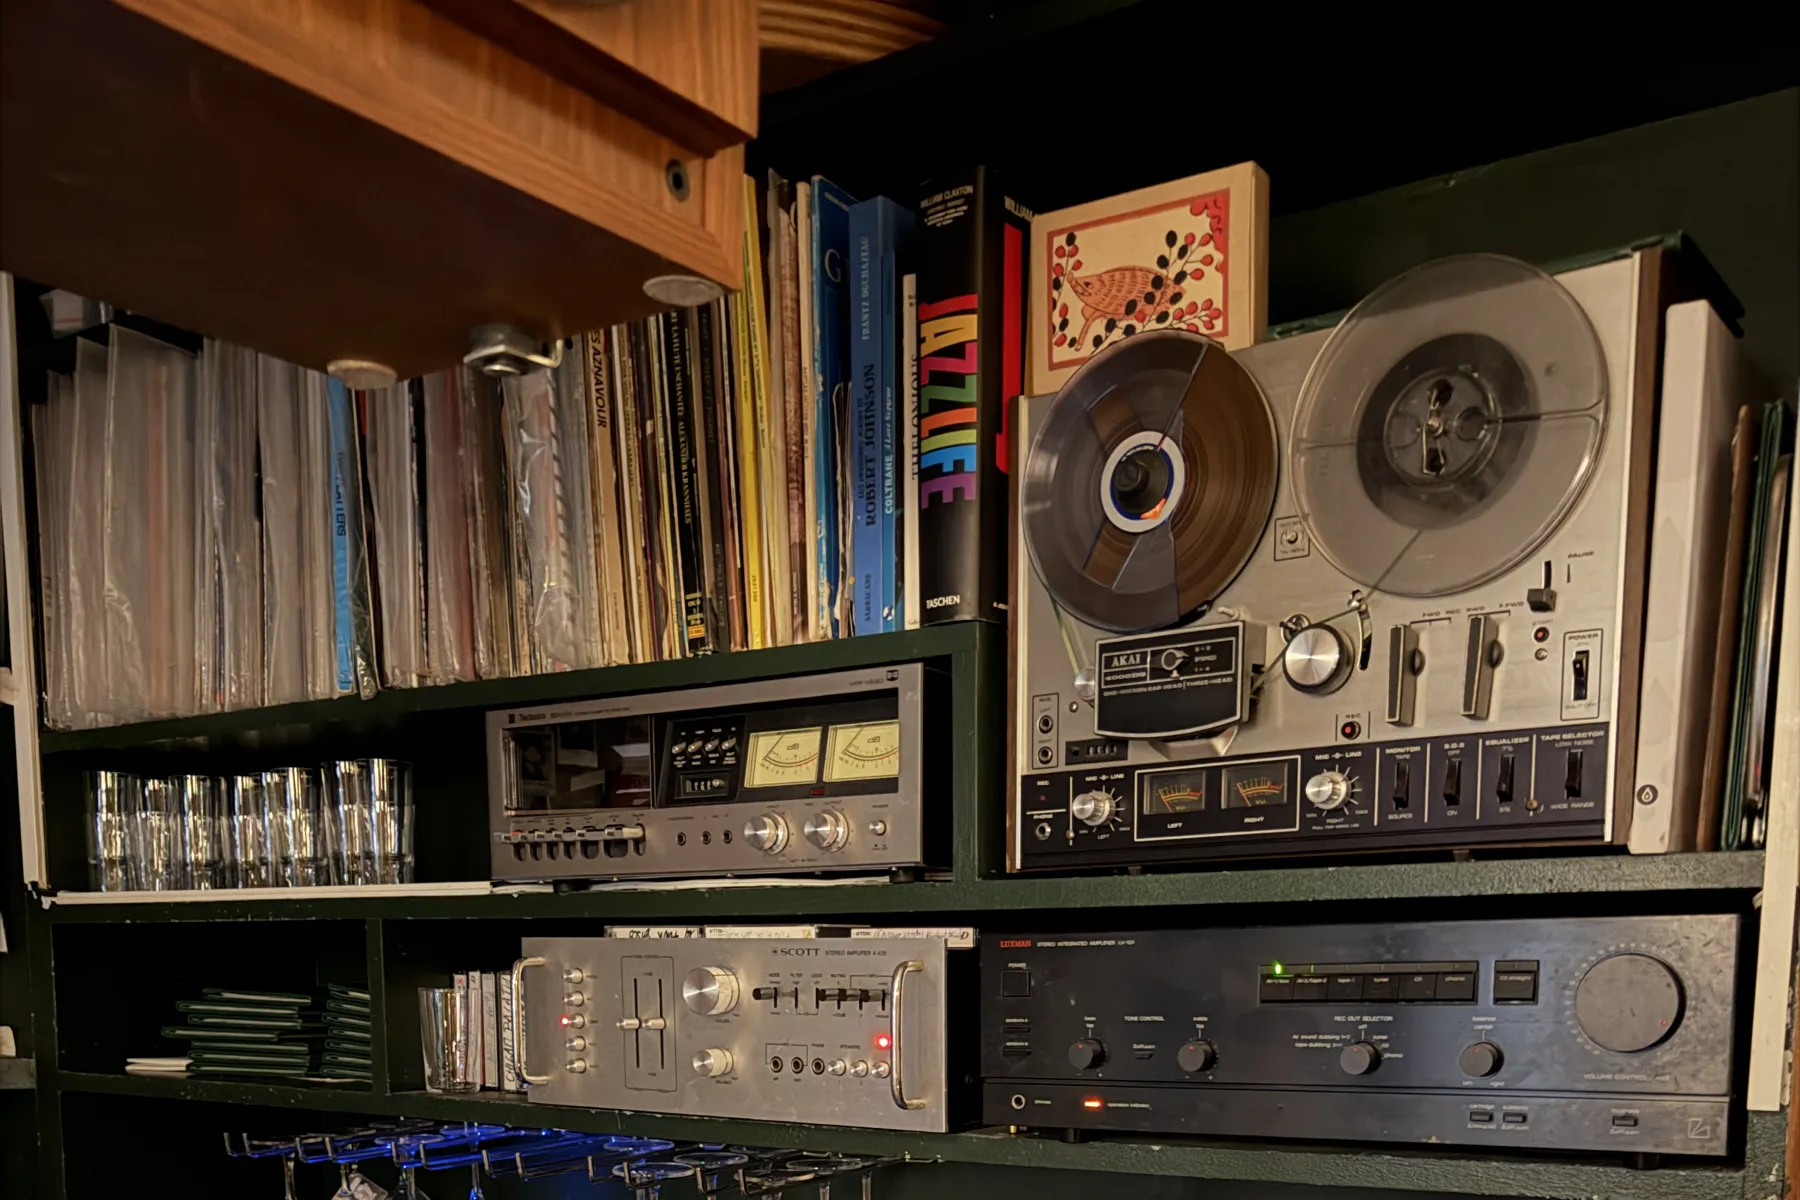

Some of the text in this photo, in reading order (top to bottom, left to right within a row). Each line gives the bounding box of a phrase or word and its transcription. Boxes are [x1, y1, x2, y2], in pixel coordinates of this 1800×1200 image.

[591, 346, 607, 429] AZNAVOUR
[919, 294, 978, 511] JAZZLIFE
[864, 363, 877, 527] ROBERT JOHNSON
[884, 454, 894, 515] COLTRANE
[926, 595, 960, 610] TASCHEN
[1111, 653, 1141, 668] AKAI
[1485, 735, 1530, 747] EQUALIZER
[1540, 729, 1604, 743] TAPE SELECTOR
[1385, 744, 1421, 756] MONITOR
[1167, 821, 1183, 829] LEFT
[1244, 815, 1264, 825] RIGHT
[1000, 940, 1032, 949] LUXMAN
[1036, 940, 1056, 948] STEREO
[1057, 940, 1088, 948] INTEGRATED
[1089, 939, 1116, 948] AMPLIFIER
[780, 947, 820, 957] SCOTT
[846, 950, 871, 958] AMPLIFIER
[1007, 961, 1027, 969] POWER
[1334, 1015, 1394, 1023] REC OUT SELECTOR
[1583, 1073, 1612, 1081] VOLUME
[1613, 1074, 1648, 1082] CONTROL
